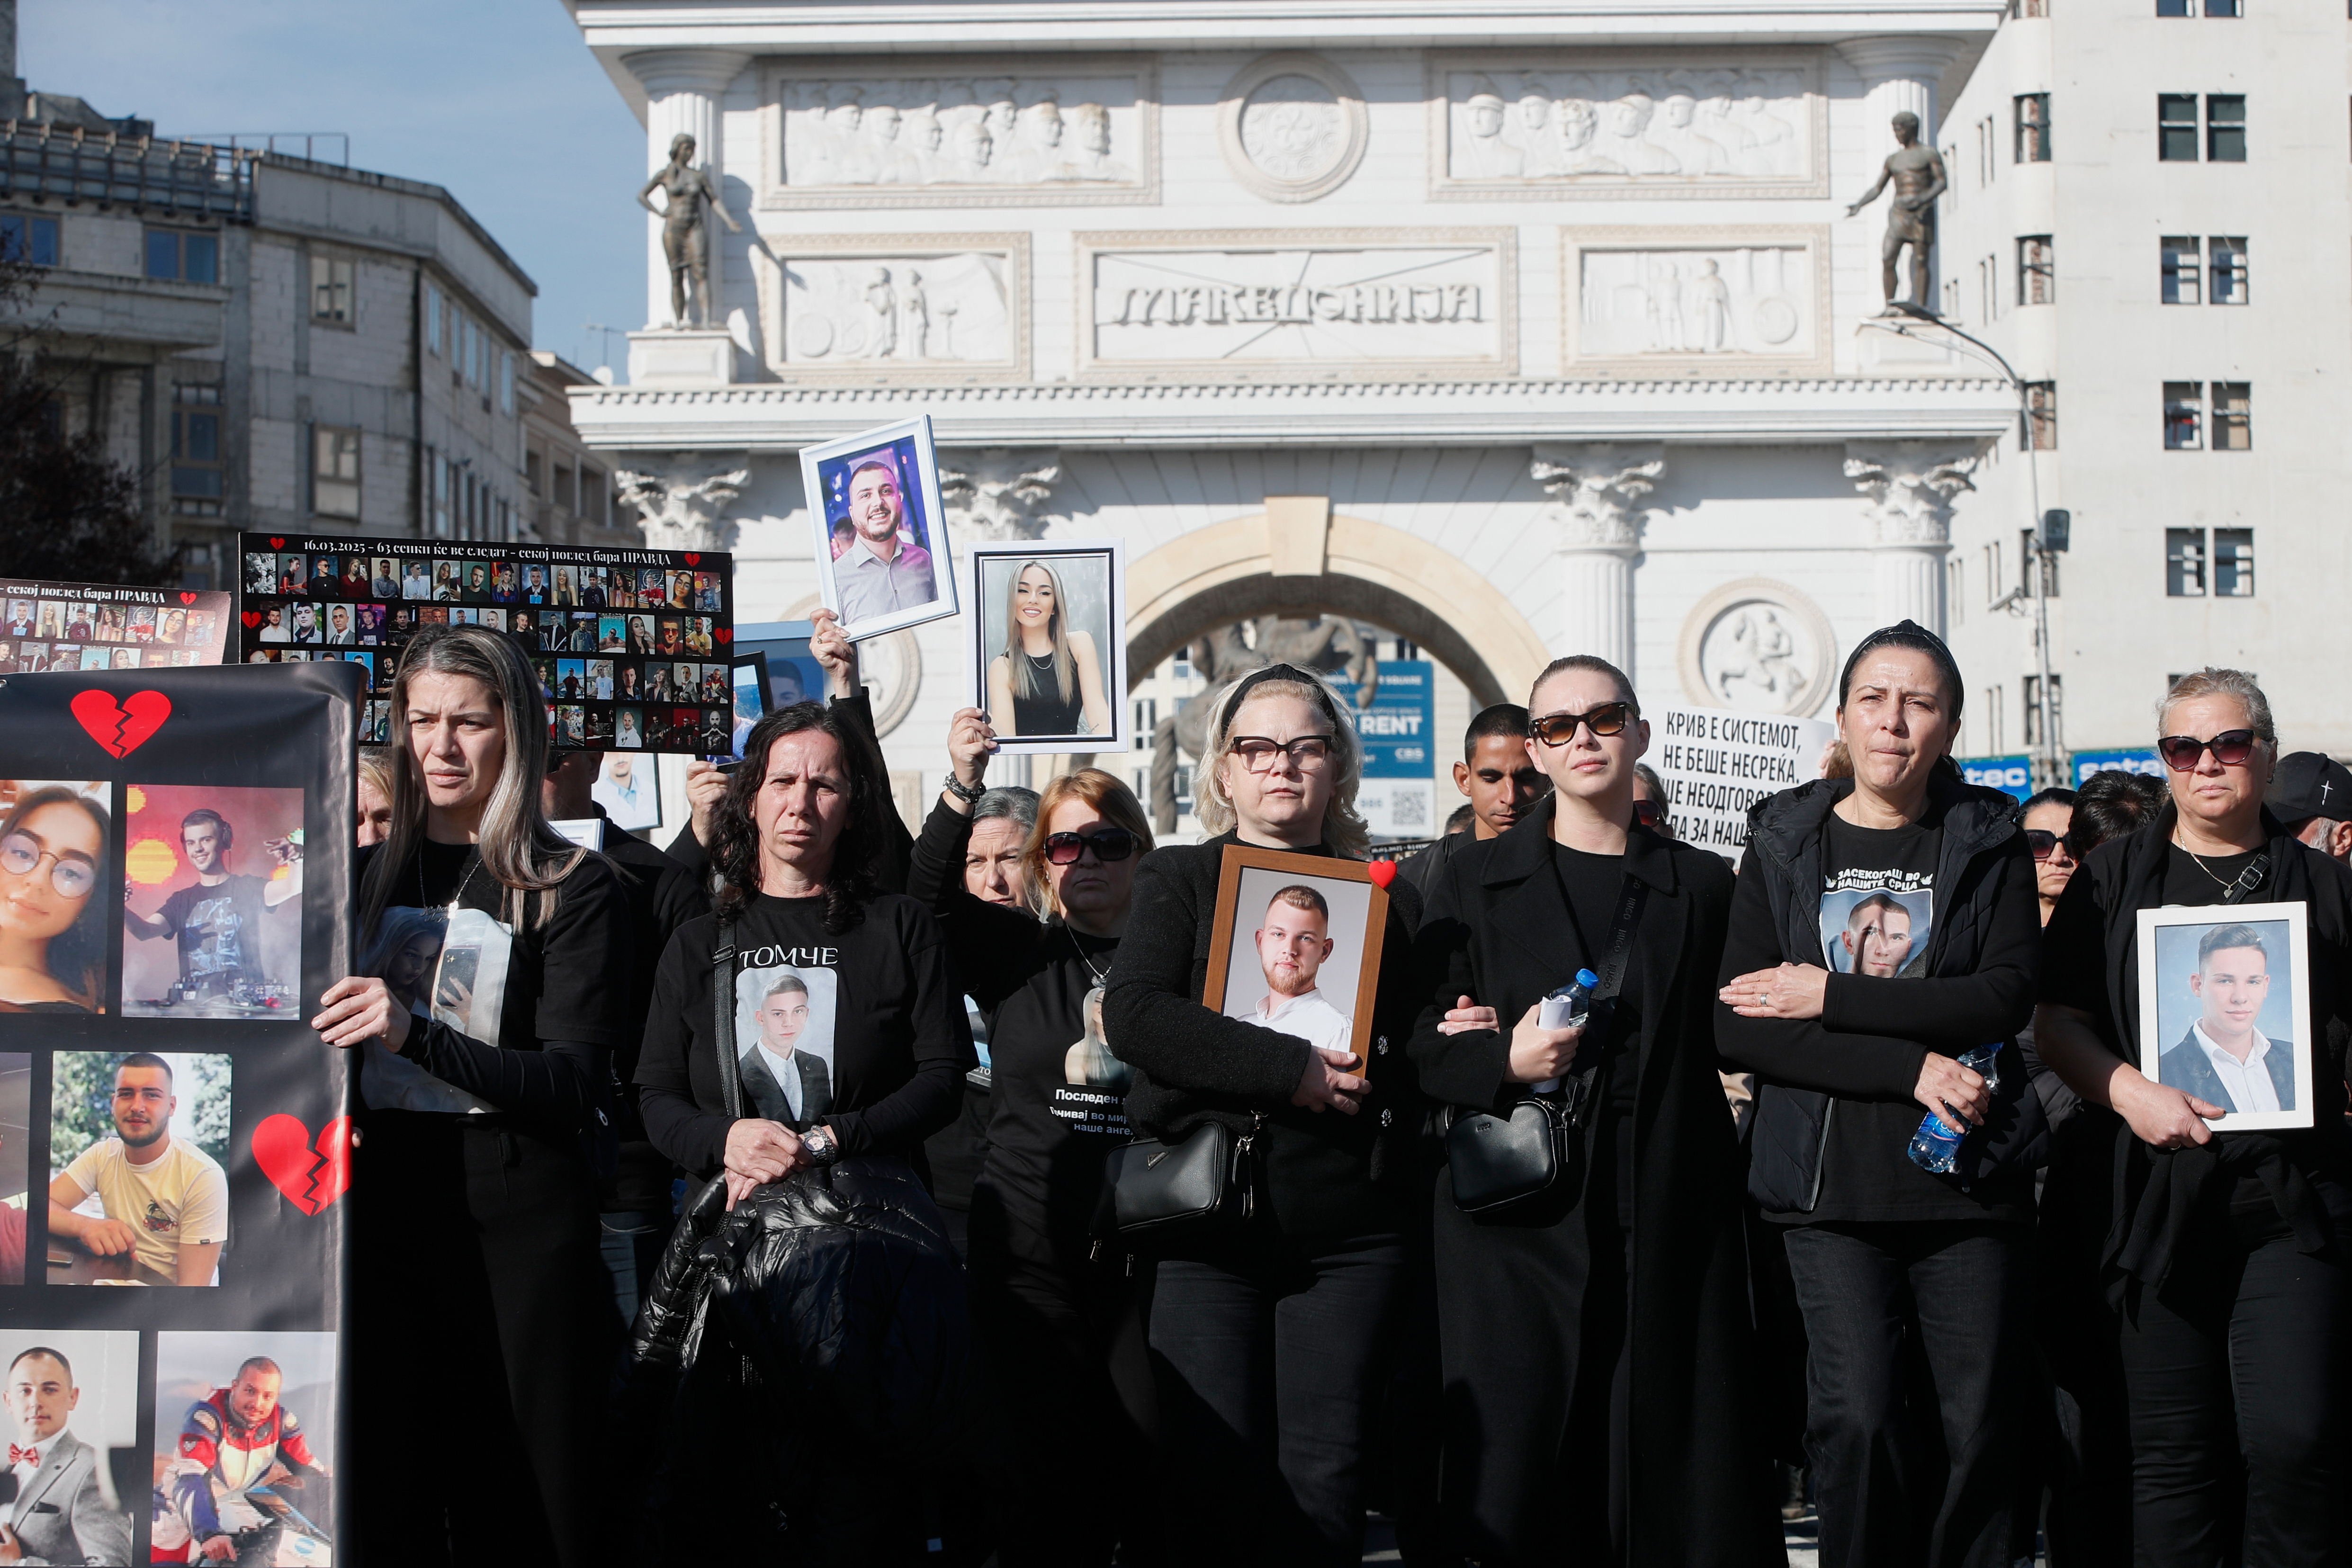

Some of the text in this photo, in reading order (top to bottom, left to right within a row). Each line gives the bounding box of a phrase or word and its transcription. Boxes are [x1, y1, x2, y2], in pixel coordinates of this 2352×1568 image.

[305, 539, 365, 554] 16.03.2025
[377, 541, 390, 555] 63
[393, 545, 431, 555] сенки
[433, 542, 448, 555] ќе
[451, 547, 464, 556] ве
[467, 547, 508, 559] следат
[519, 547, 549, 562] секој
[552, 550, 591, 564] поглед
[593, 550, 619, 565] бара
[623, 552, 671, 566] ПРАВДА
[7, 584, 39, 597] секој
[41, 588, 81, 600] поглед
[84, 588, 112, 601] бара
[115, 590, 165, 604] ПРАВДА
[1359, 716, 1422, 735] RENT
[1666, 711, 1801, 755] КРИВ Е СИСТЕМОТ,
[1663, 744, 1800, 784] НЕ БЕШЕ НЕСРЕЌА.
[1965, 767, 2027, 788] tec
[1662, 779, 1683, 805] ШЕ
[1690, 817, 1709, 842] ЗА
[1712, 820, 1747, 847] НАШ
[1837, 868, 1921, 881] ЗАСЕКОГАШ ВО
[1837, 878, 1918, 891] НАШИТЕ СРЦА
[739, 944, 838, 968] ТОМЧЕ
[1055, 1089, 1118, 1104] Последен
[1074, 1124, 1133, 1135] наше анге
